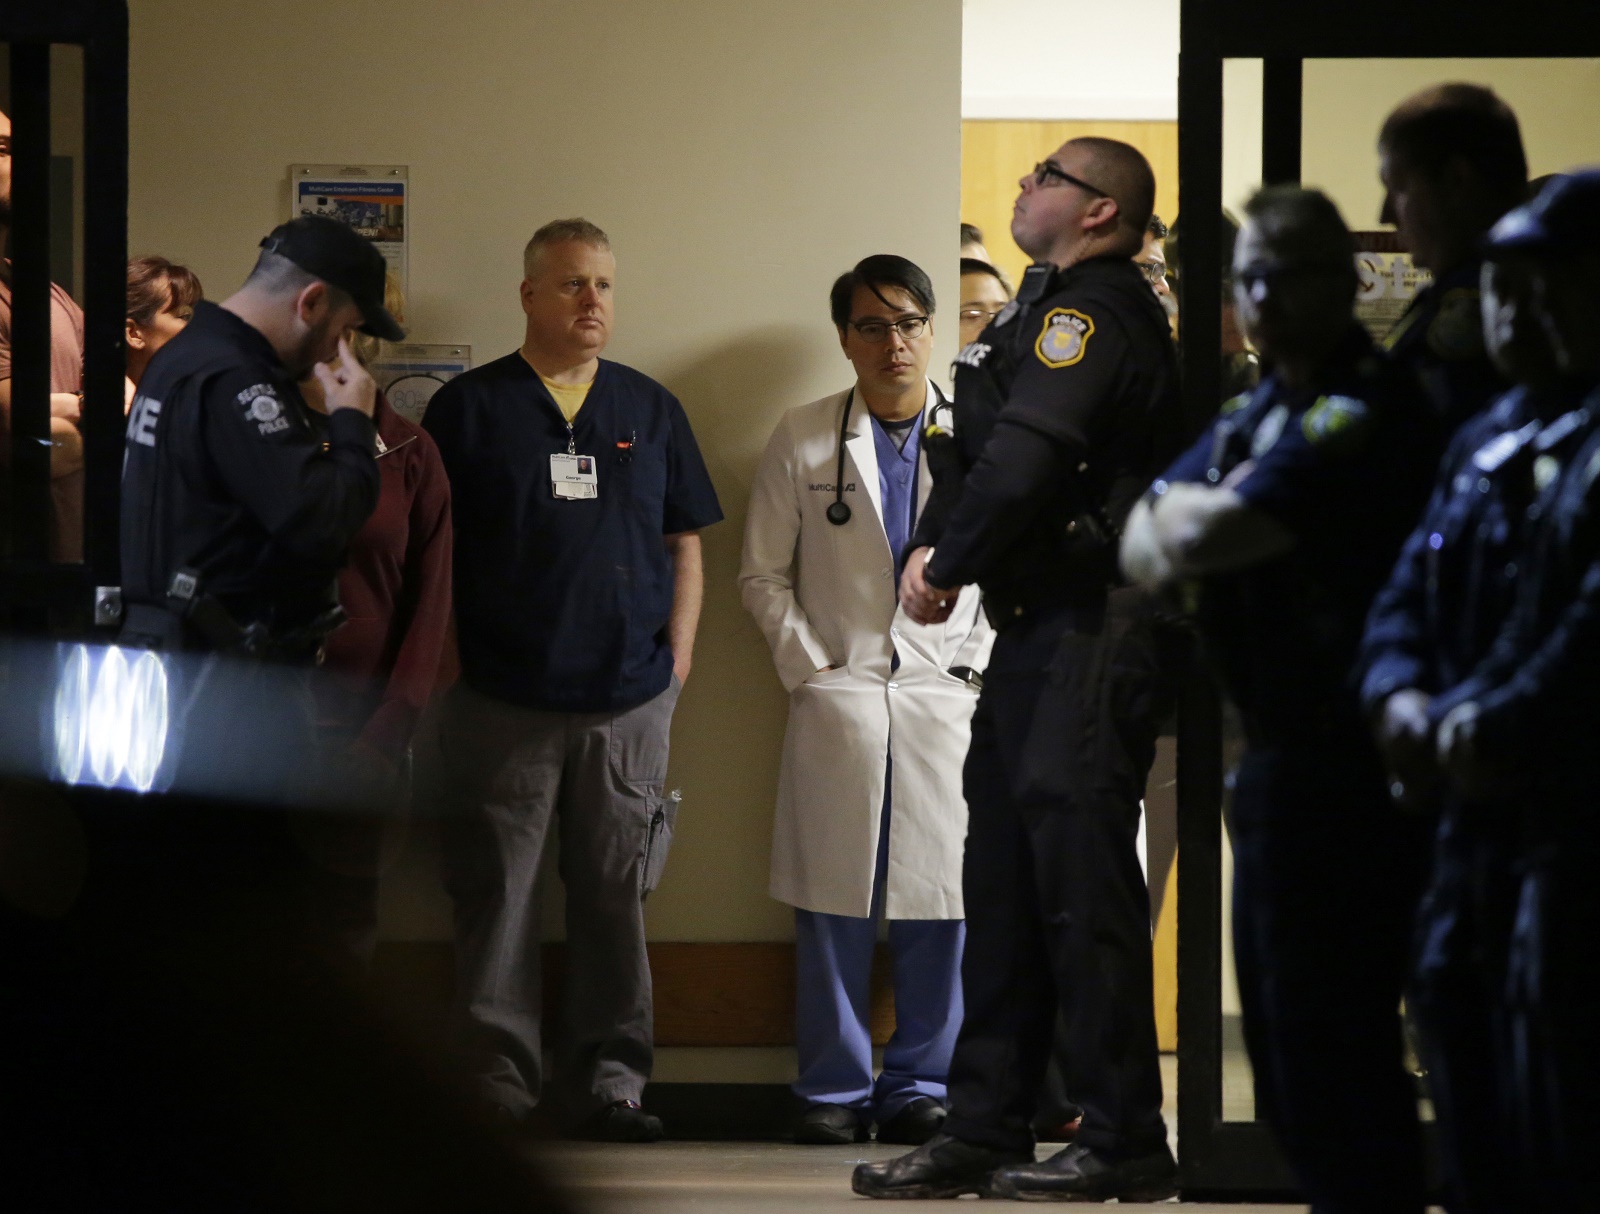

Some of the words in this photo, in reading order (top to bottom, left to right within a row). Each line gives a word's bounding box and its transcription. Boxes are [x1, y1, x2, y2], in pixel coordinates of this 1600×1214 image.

[355, 228, 379, 237] PEN!
[1052, 314, 1087, 332] POLICE
[258, 415, 290, 436] POLICE
[808, 483, 844, 491] MultiCa
